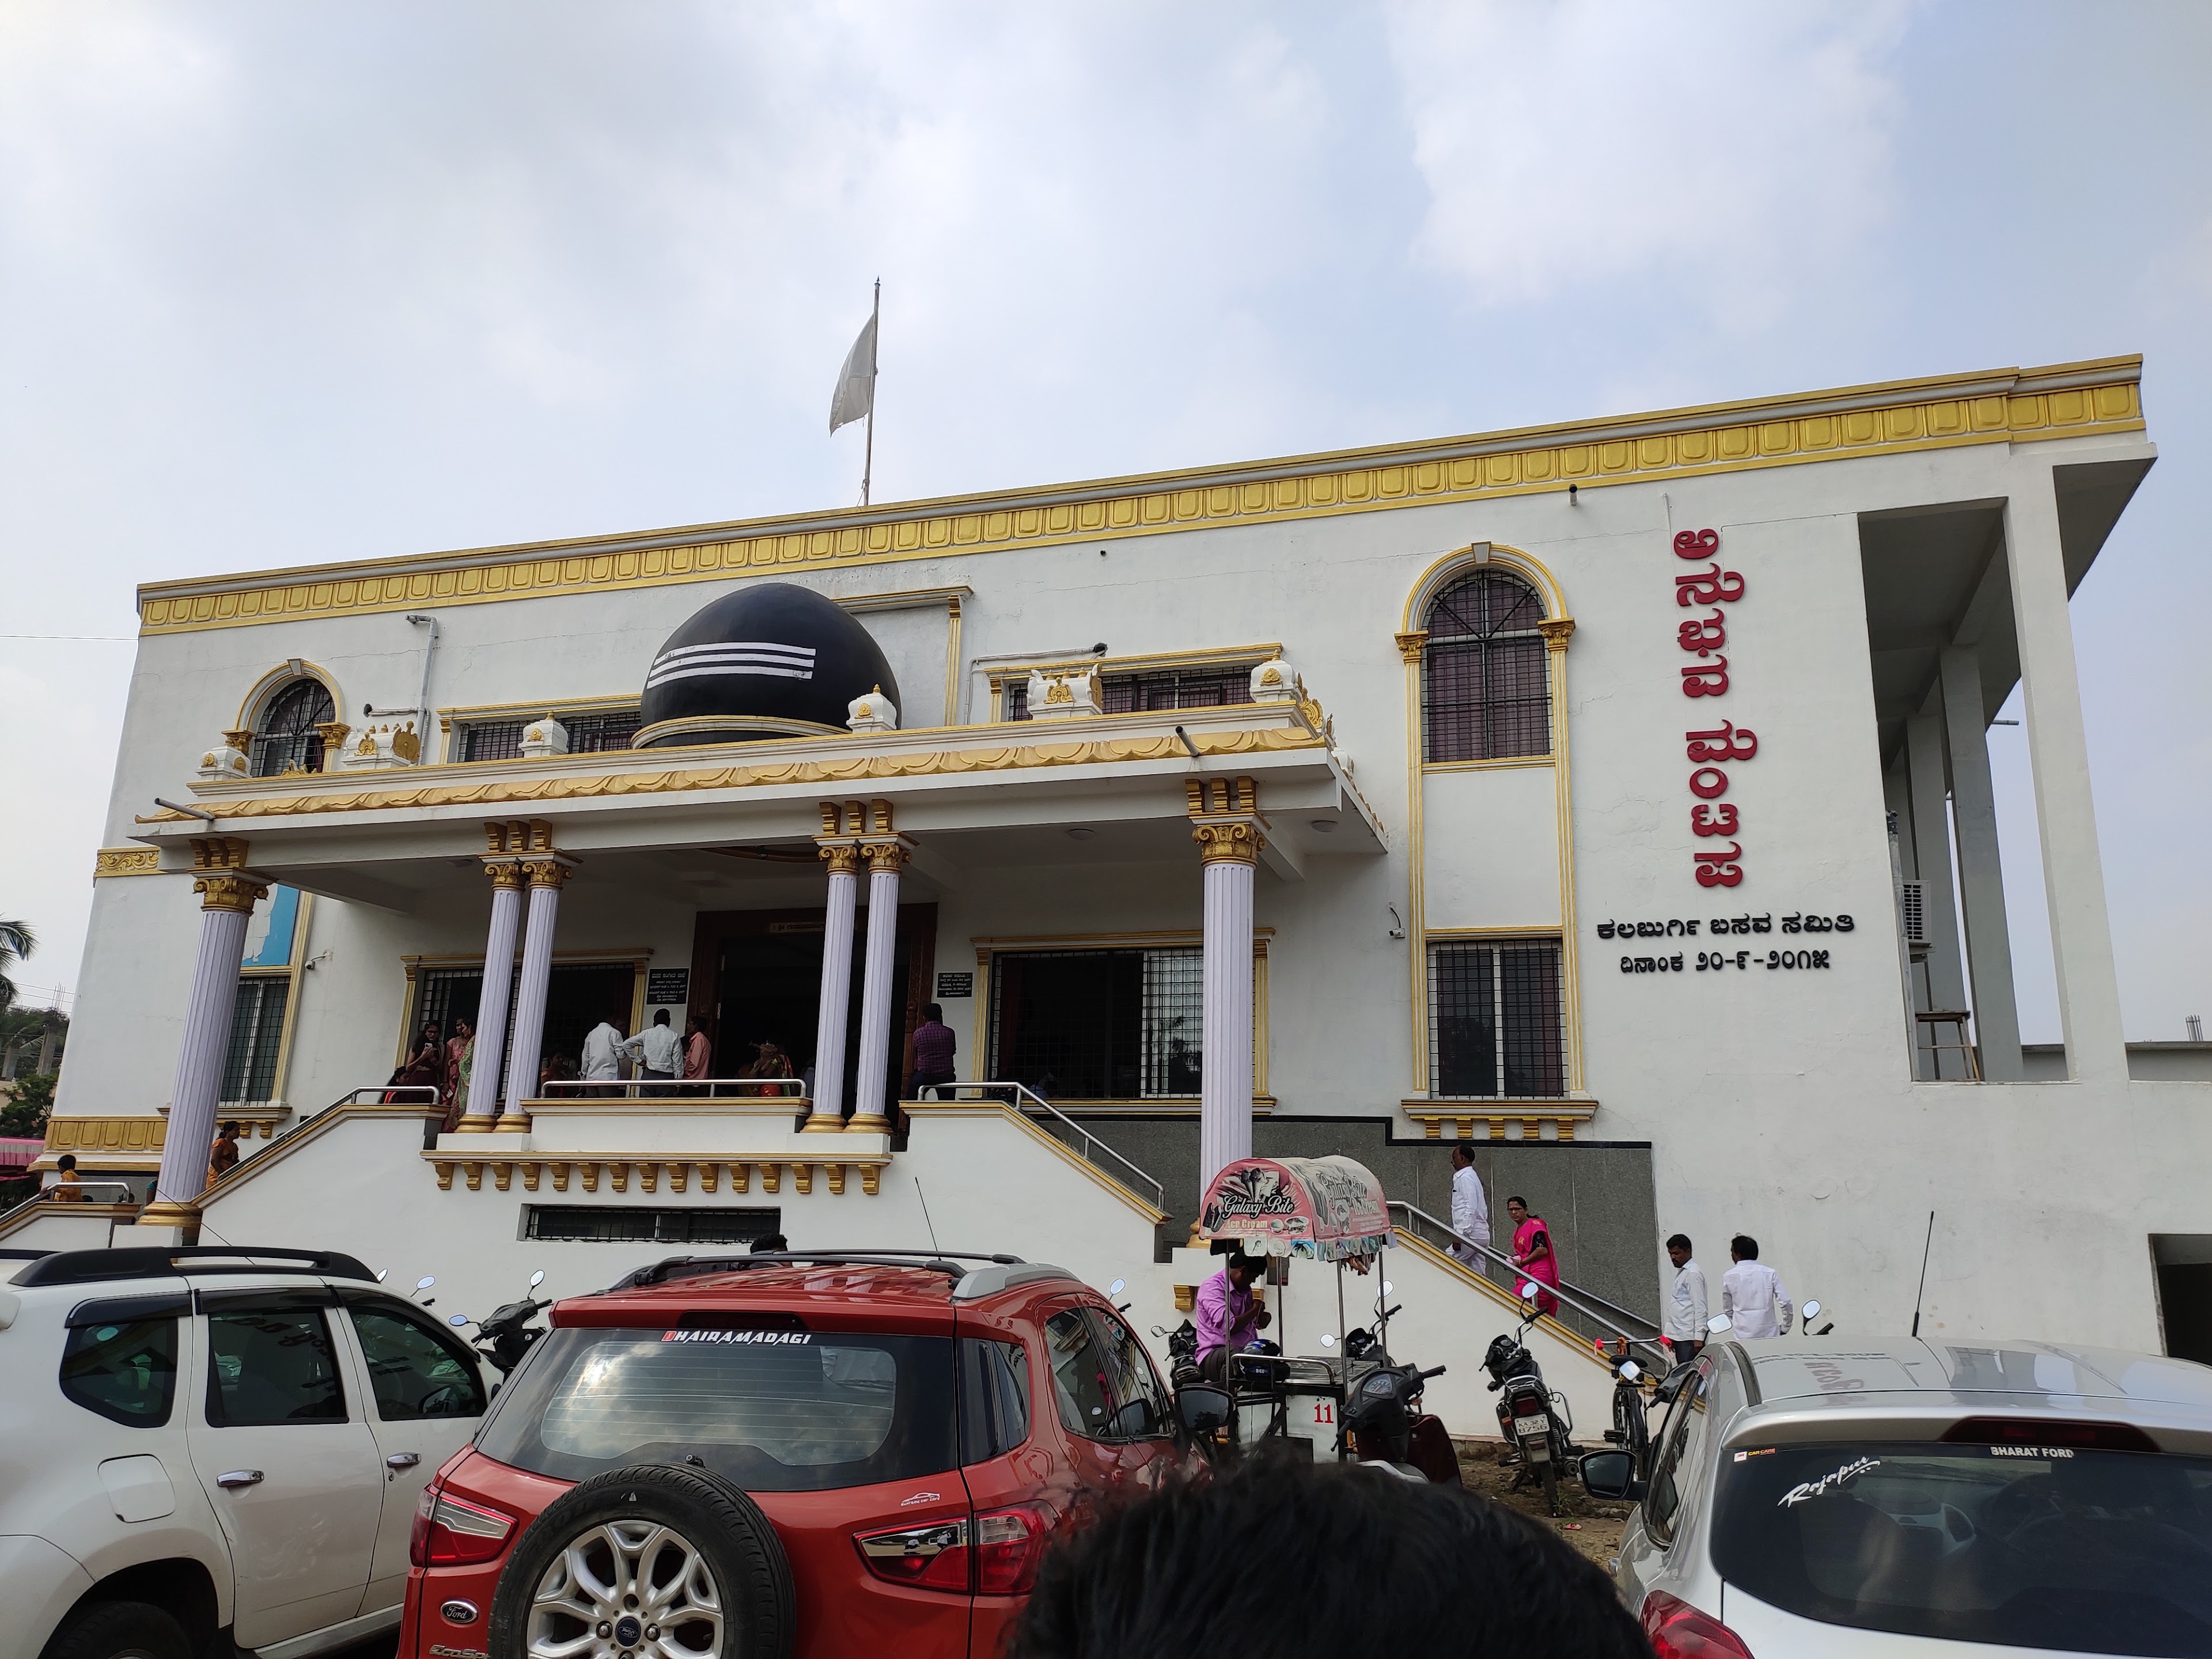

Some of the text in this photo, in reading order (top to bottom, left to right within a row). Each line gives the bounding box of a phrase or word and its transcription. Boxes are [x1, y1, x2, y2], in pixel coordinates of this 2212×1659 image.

[1673, 528, 1758, 888] ಅನುಭವ ಮಂಟಪ
[1597, 911, 1854, 939] ಕಲಬುರ್ಗಿ ಬಸವ ಸಮಿತಿ
[1620, 951, 1683, 973] ದಿನಾಂಕ
[1222, 1195, 1294, 1219] Galaxy Bite
[1241, 1219, 1267, 1229] Cream
[1314, 1403, 1334, 1424] 11
[1990, 1446, 2074, 1458] BHARAT FORD
[1777, 1456, 1872, 1508] Rajapur
[446, 1605, 468, 1619] Ford
